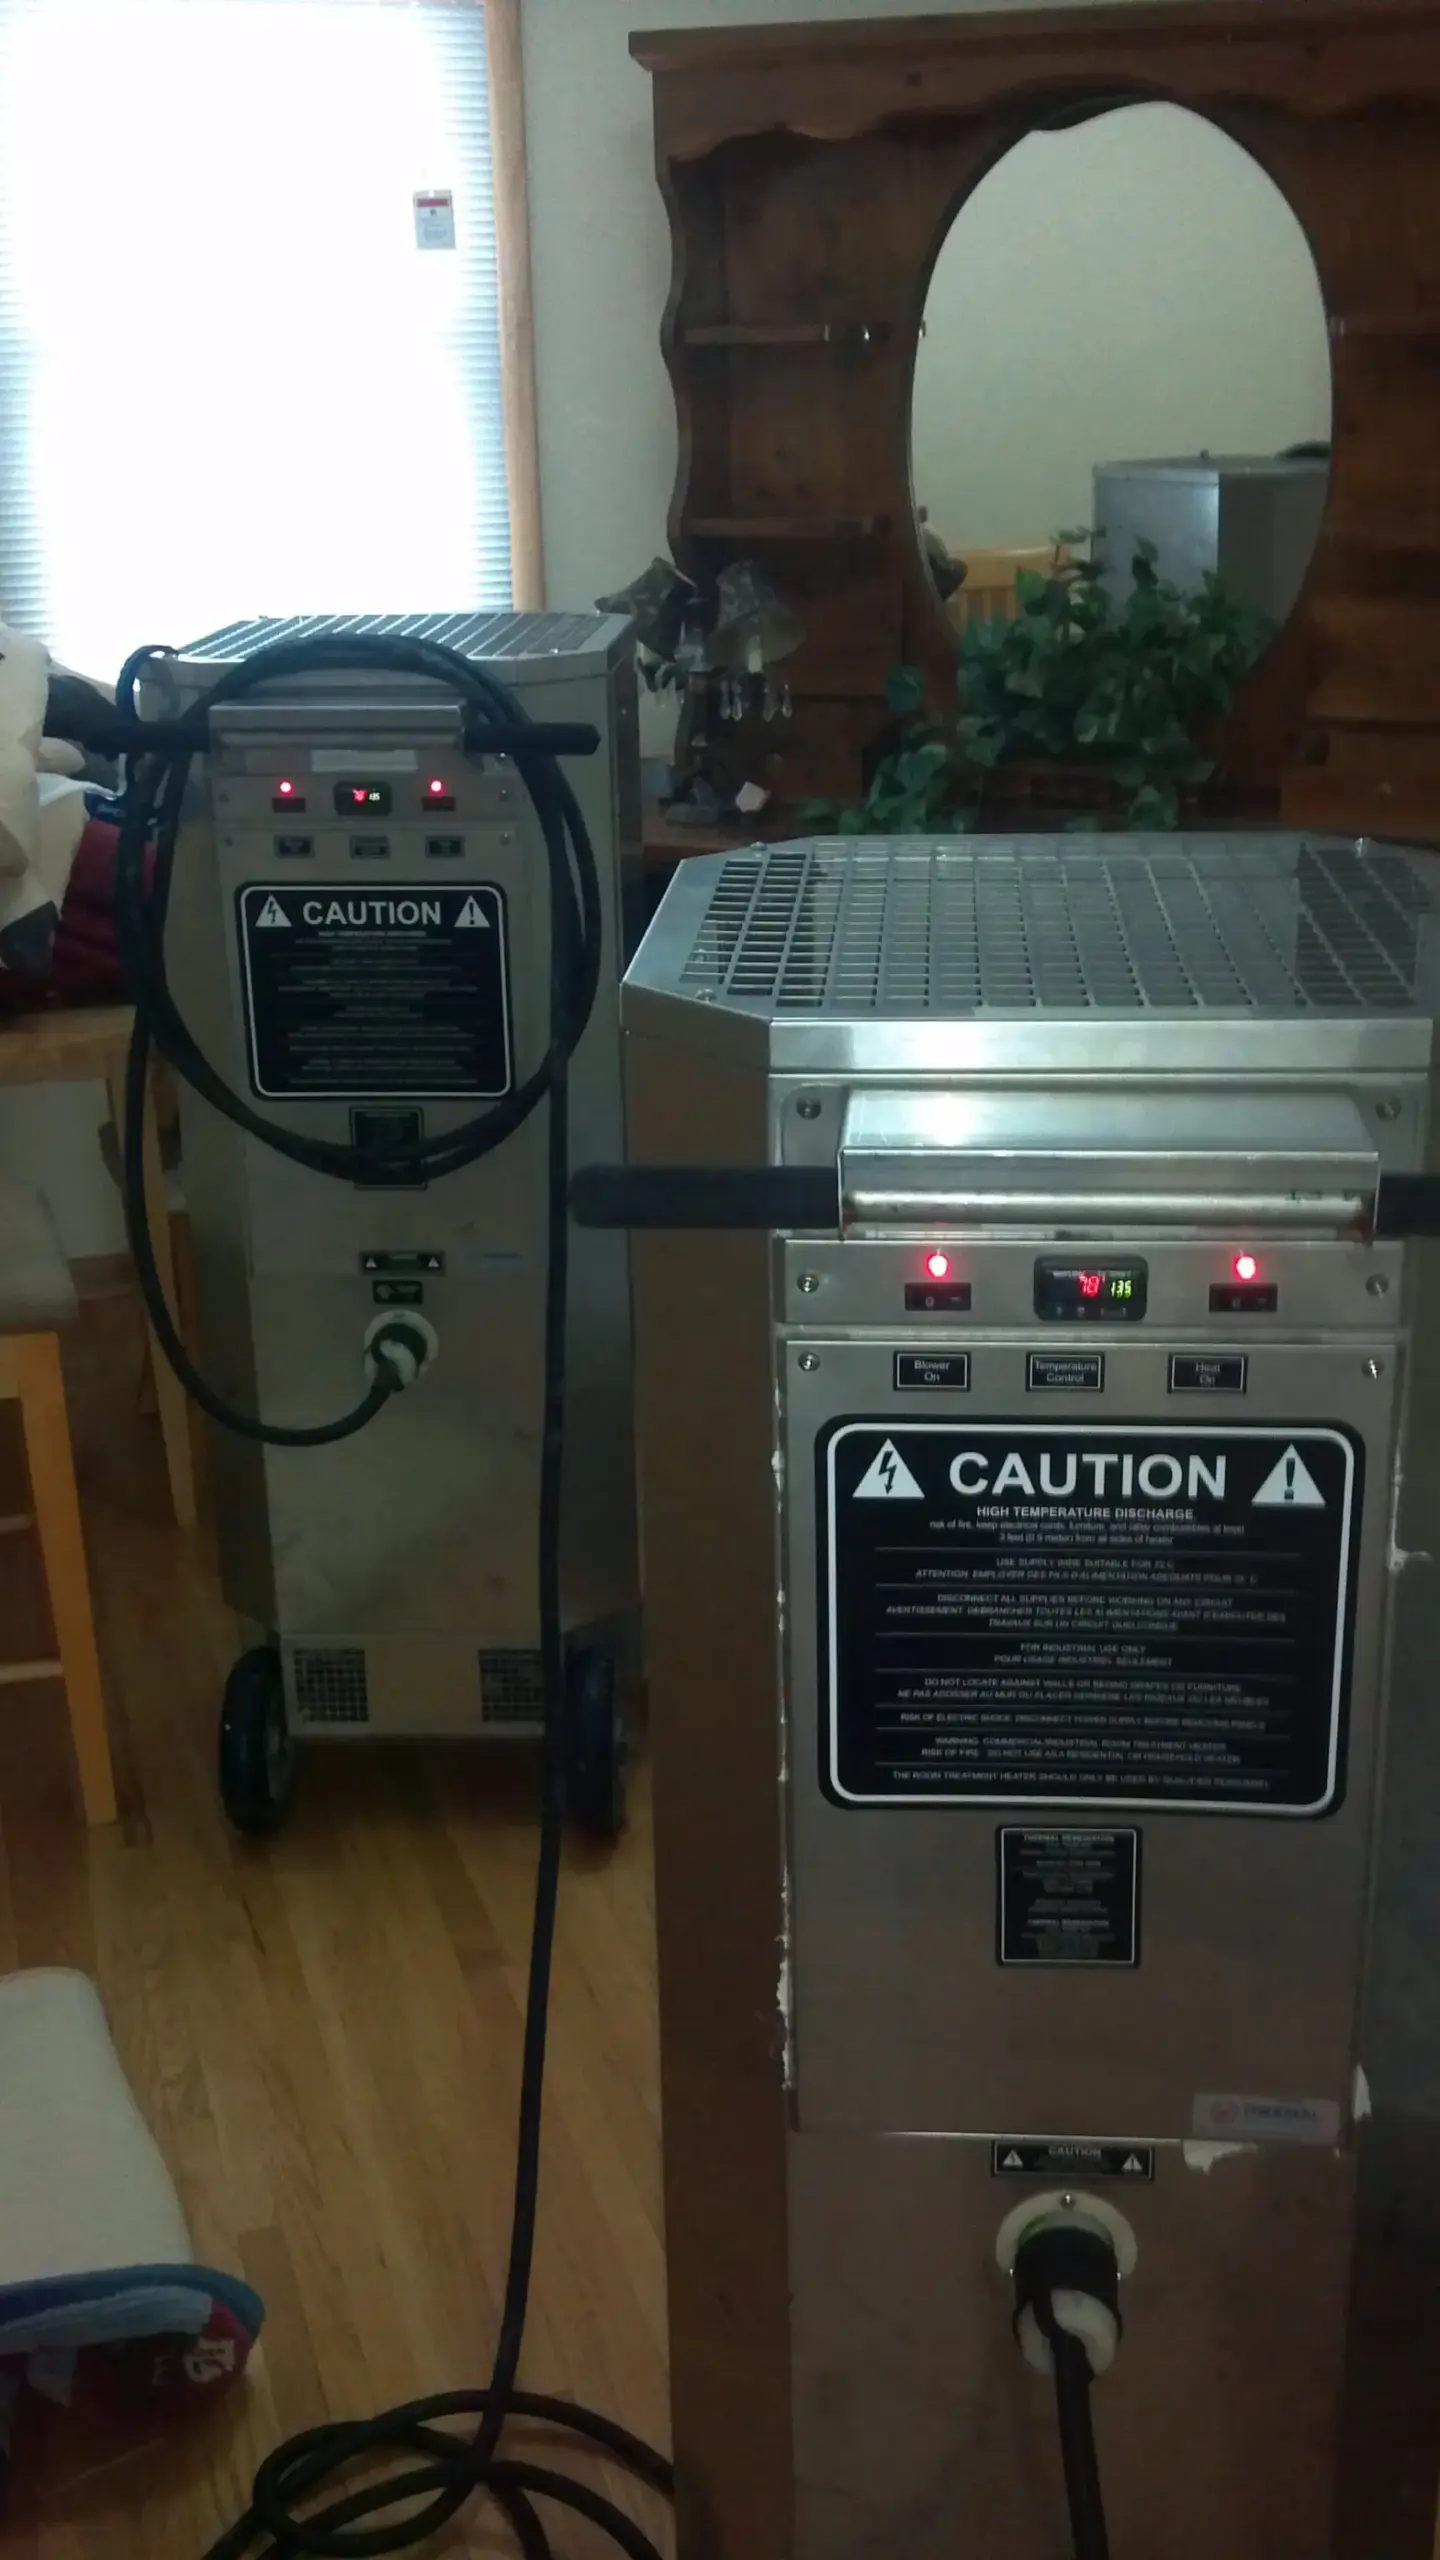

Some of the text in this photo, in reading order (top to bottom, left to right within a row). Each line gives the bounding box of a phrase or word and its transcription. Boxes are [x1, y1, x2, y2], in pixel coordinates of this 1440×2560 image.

[302, 900, 442, 926] CAUTION
[1111, 1280, 1132, 1299] 135
[914, 1360, 951, 1372] Blower
[1036, 1361, 1098, 1375] Temperature
[1195, 1362, 1221, 1374] Heat
[924, 1372, 941, 1384] On
[1046, 1373, 1085, 1384] Control
[1199, 1374, 1216, 1386] On
[949, 1451, 1227, 1499] CAUTION
[976, 1506, 1194, 1519] HIGH TEMPERATURE DISCHARGE
[1049, 2145, 1102, 2158] CAUTION
